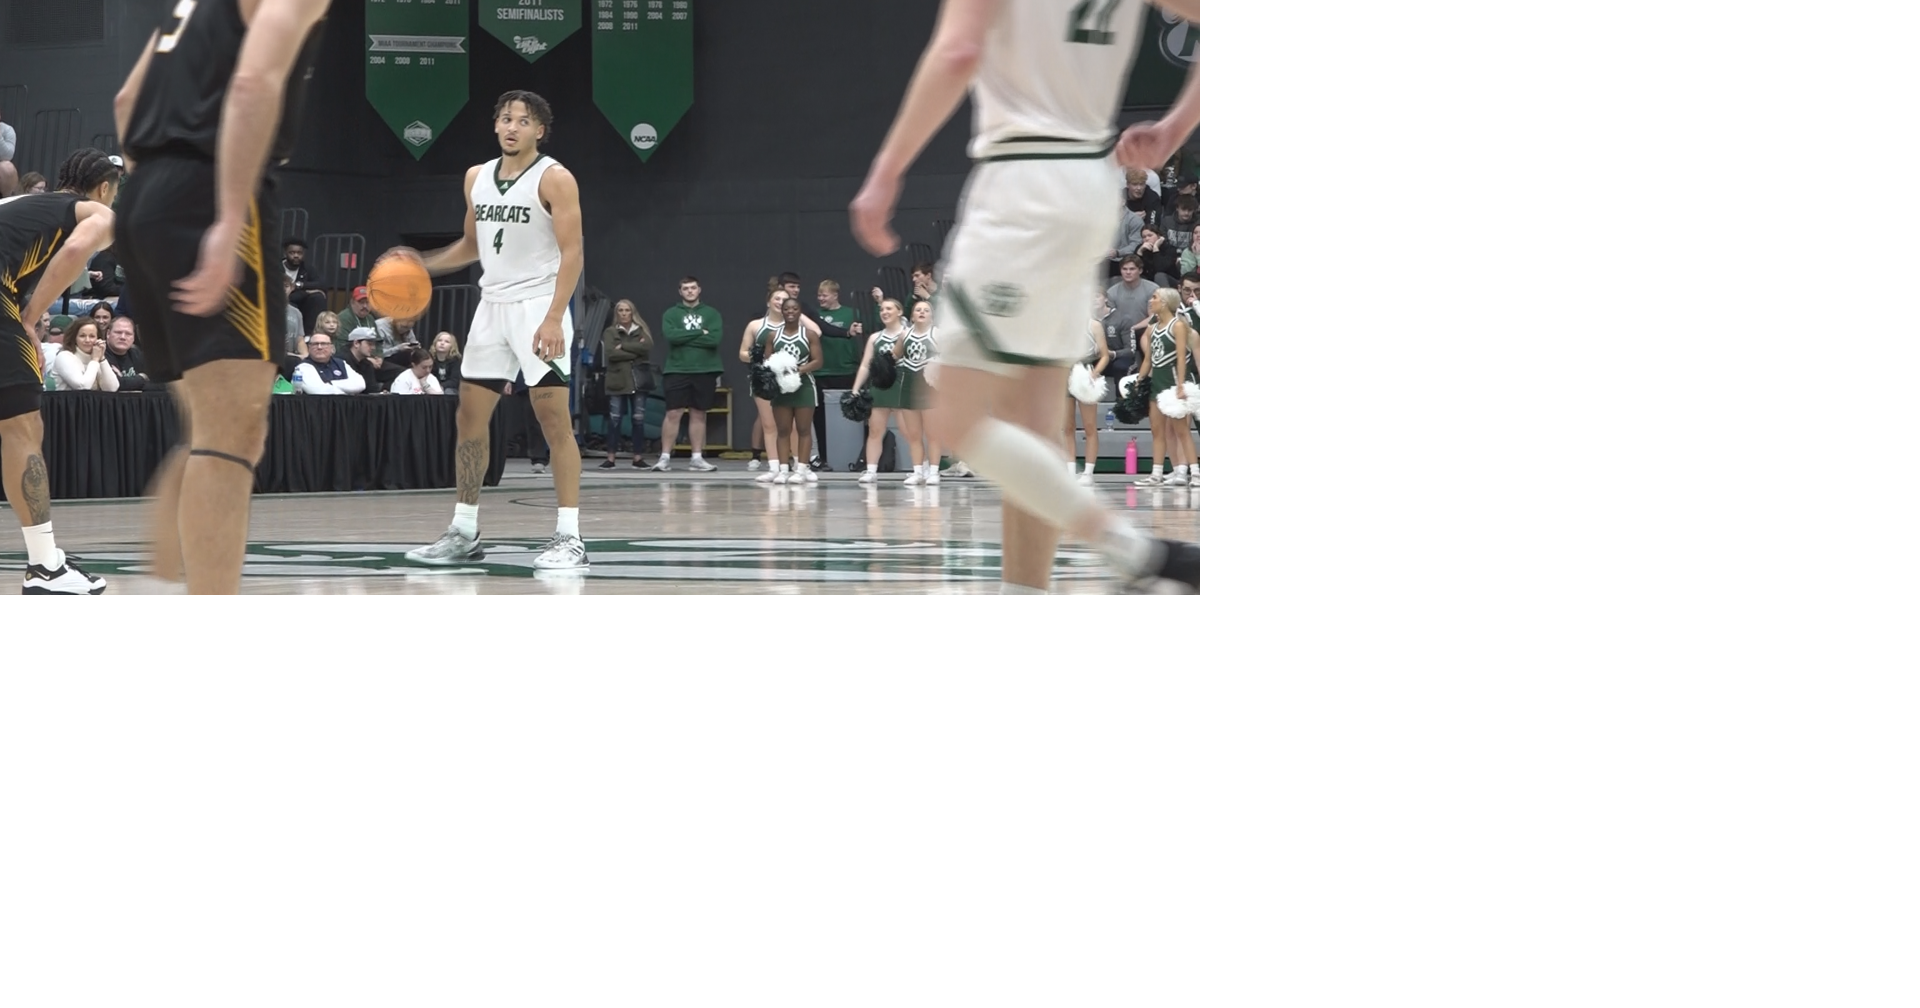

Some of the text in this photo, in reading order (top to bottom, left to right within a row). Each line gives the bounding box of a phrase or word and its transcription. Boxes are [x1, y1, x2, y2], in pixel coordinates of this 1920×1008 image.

[496, 8, 564, 20] SEMIFINALISTS
[672, 12, 688, 20] 2007
[622, 22, 638, 30] 2011
[369, 56, 385, 64] 2004
[634, 135, 656, 143] NCAA
[475, 204, 531, 223] BEARCATS
[493, 228, 504, 254] 4
